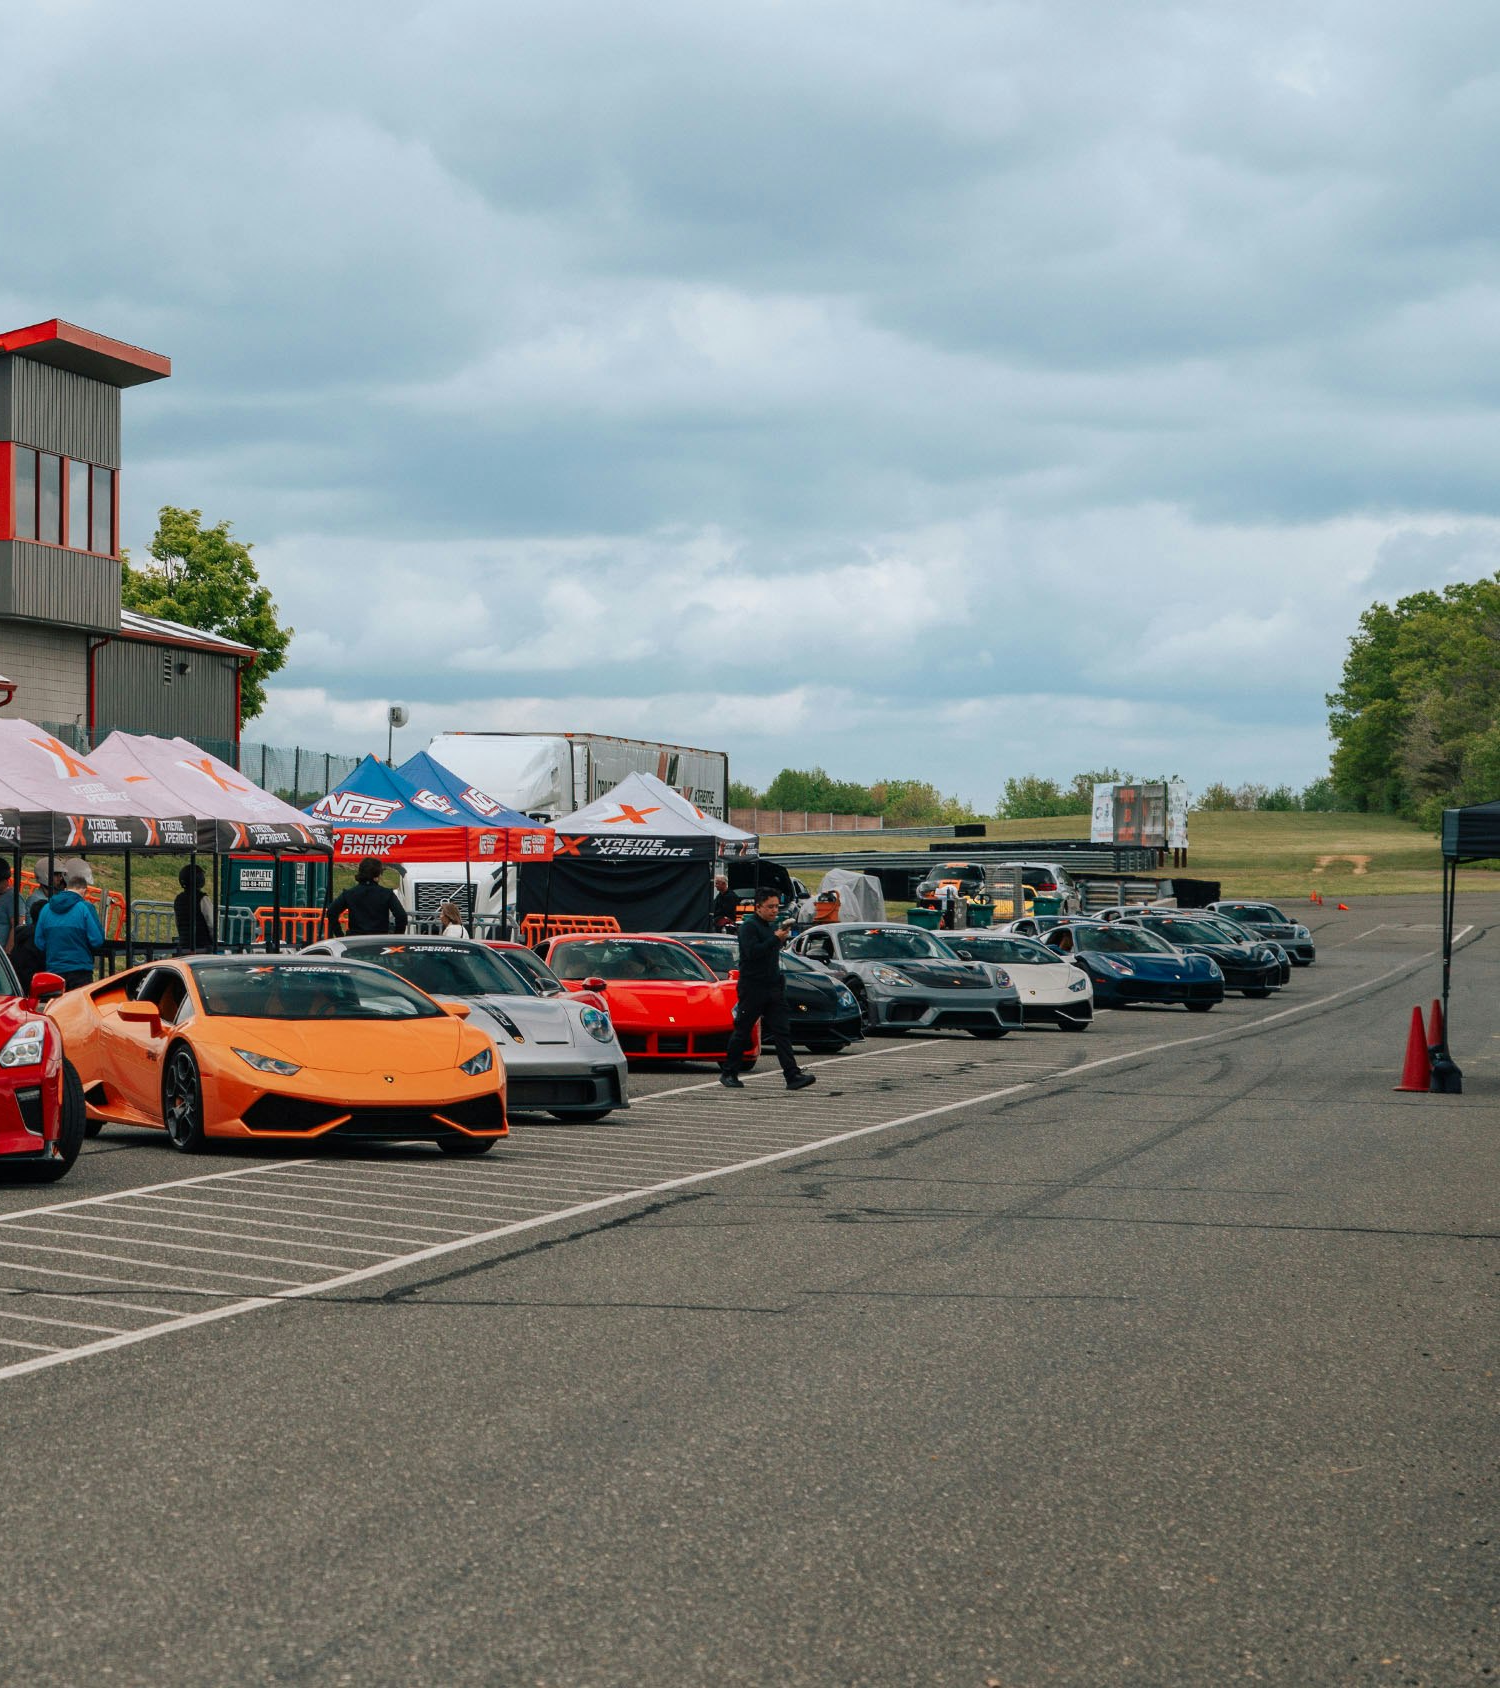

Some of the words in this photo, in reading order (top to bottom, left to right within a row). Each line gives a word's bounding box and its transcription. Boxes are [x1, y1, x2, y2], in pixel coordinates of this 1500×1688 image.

[313, 792, 405, 821] NOS
[87, 818, 119, 831] XTREME
[312, 812, 350, 823] ENERGY
[350, 817, 383, 825] DRINK
[159, 820, 185, 832] XTREME
[92, 831, 133, 844] XPERIENCE
[164, 831, 194, 845] XPERIENCE
[255, 833, 292, 845] XPERIENCE
[342, 834, 408, 845] ENERGY
[591, 839, 666, 848] XTREME
[340, 845, 391, 856] DRINK
[598, 847, 693, 857] XPERIENCE
[241, 870, 272, 878] COMPLETE
